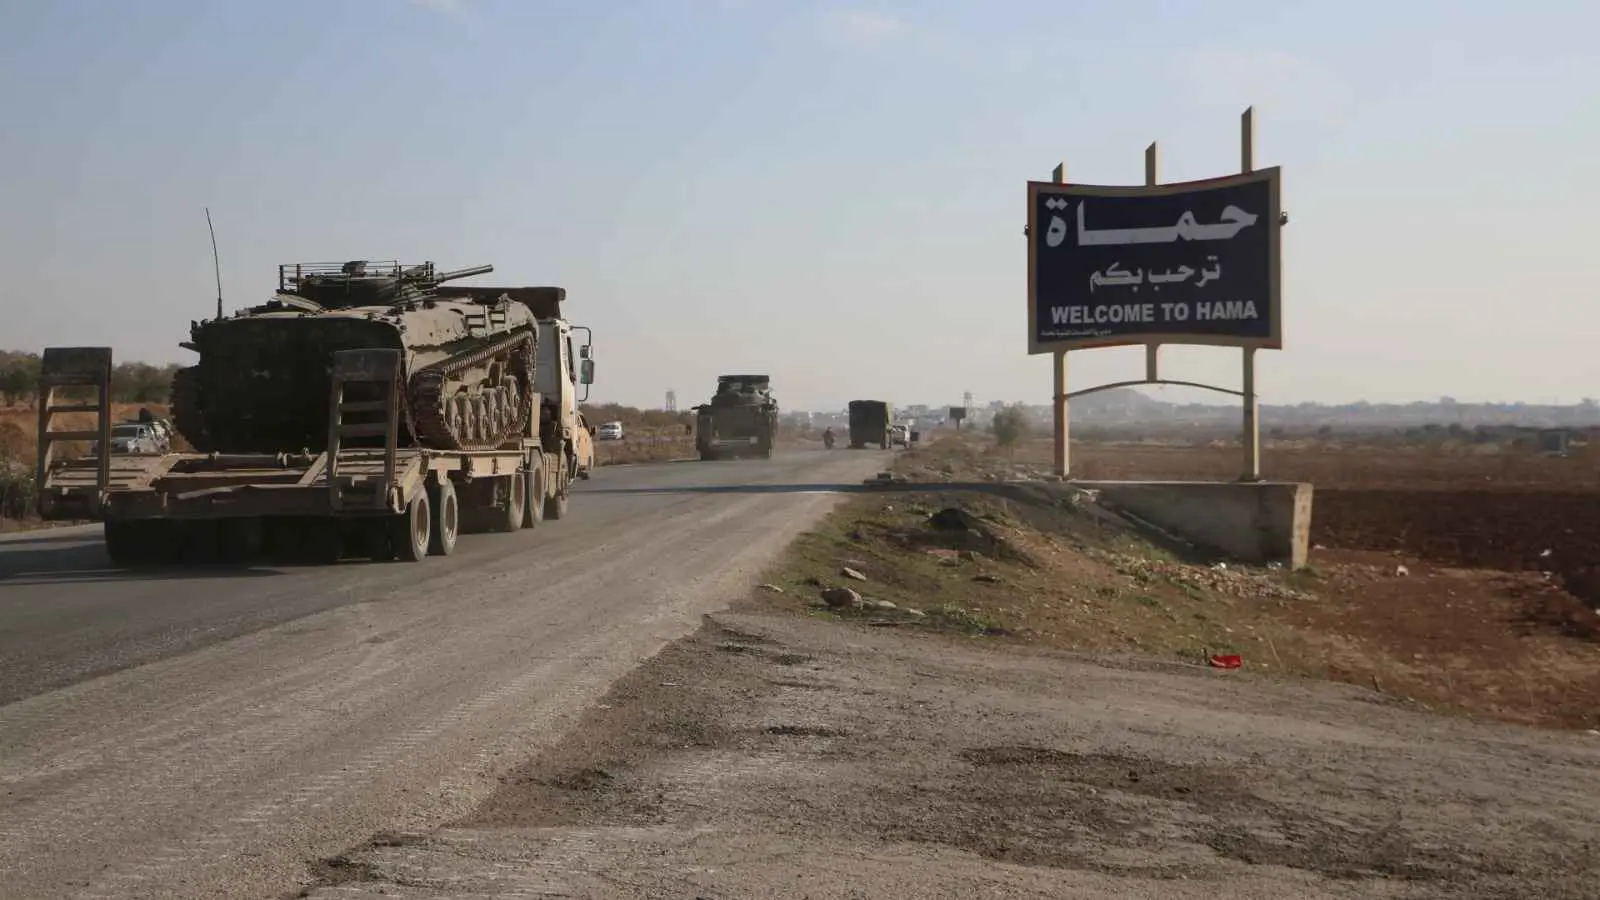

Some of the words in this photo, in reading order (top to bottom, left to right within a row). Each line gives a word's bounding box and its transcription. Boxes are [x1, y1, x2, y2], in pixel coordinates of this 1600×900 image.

[1090, 261, 1143, 293] بكم
[1148, 255, 1221, 291] ترحب
[1051, 303, 1155, 324] WELCOME
[1161, 302, 1189, 321] TO
[1196, 300, 1259, 321] HAMA
